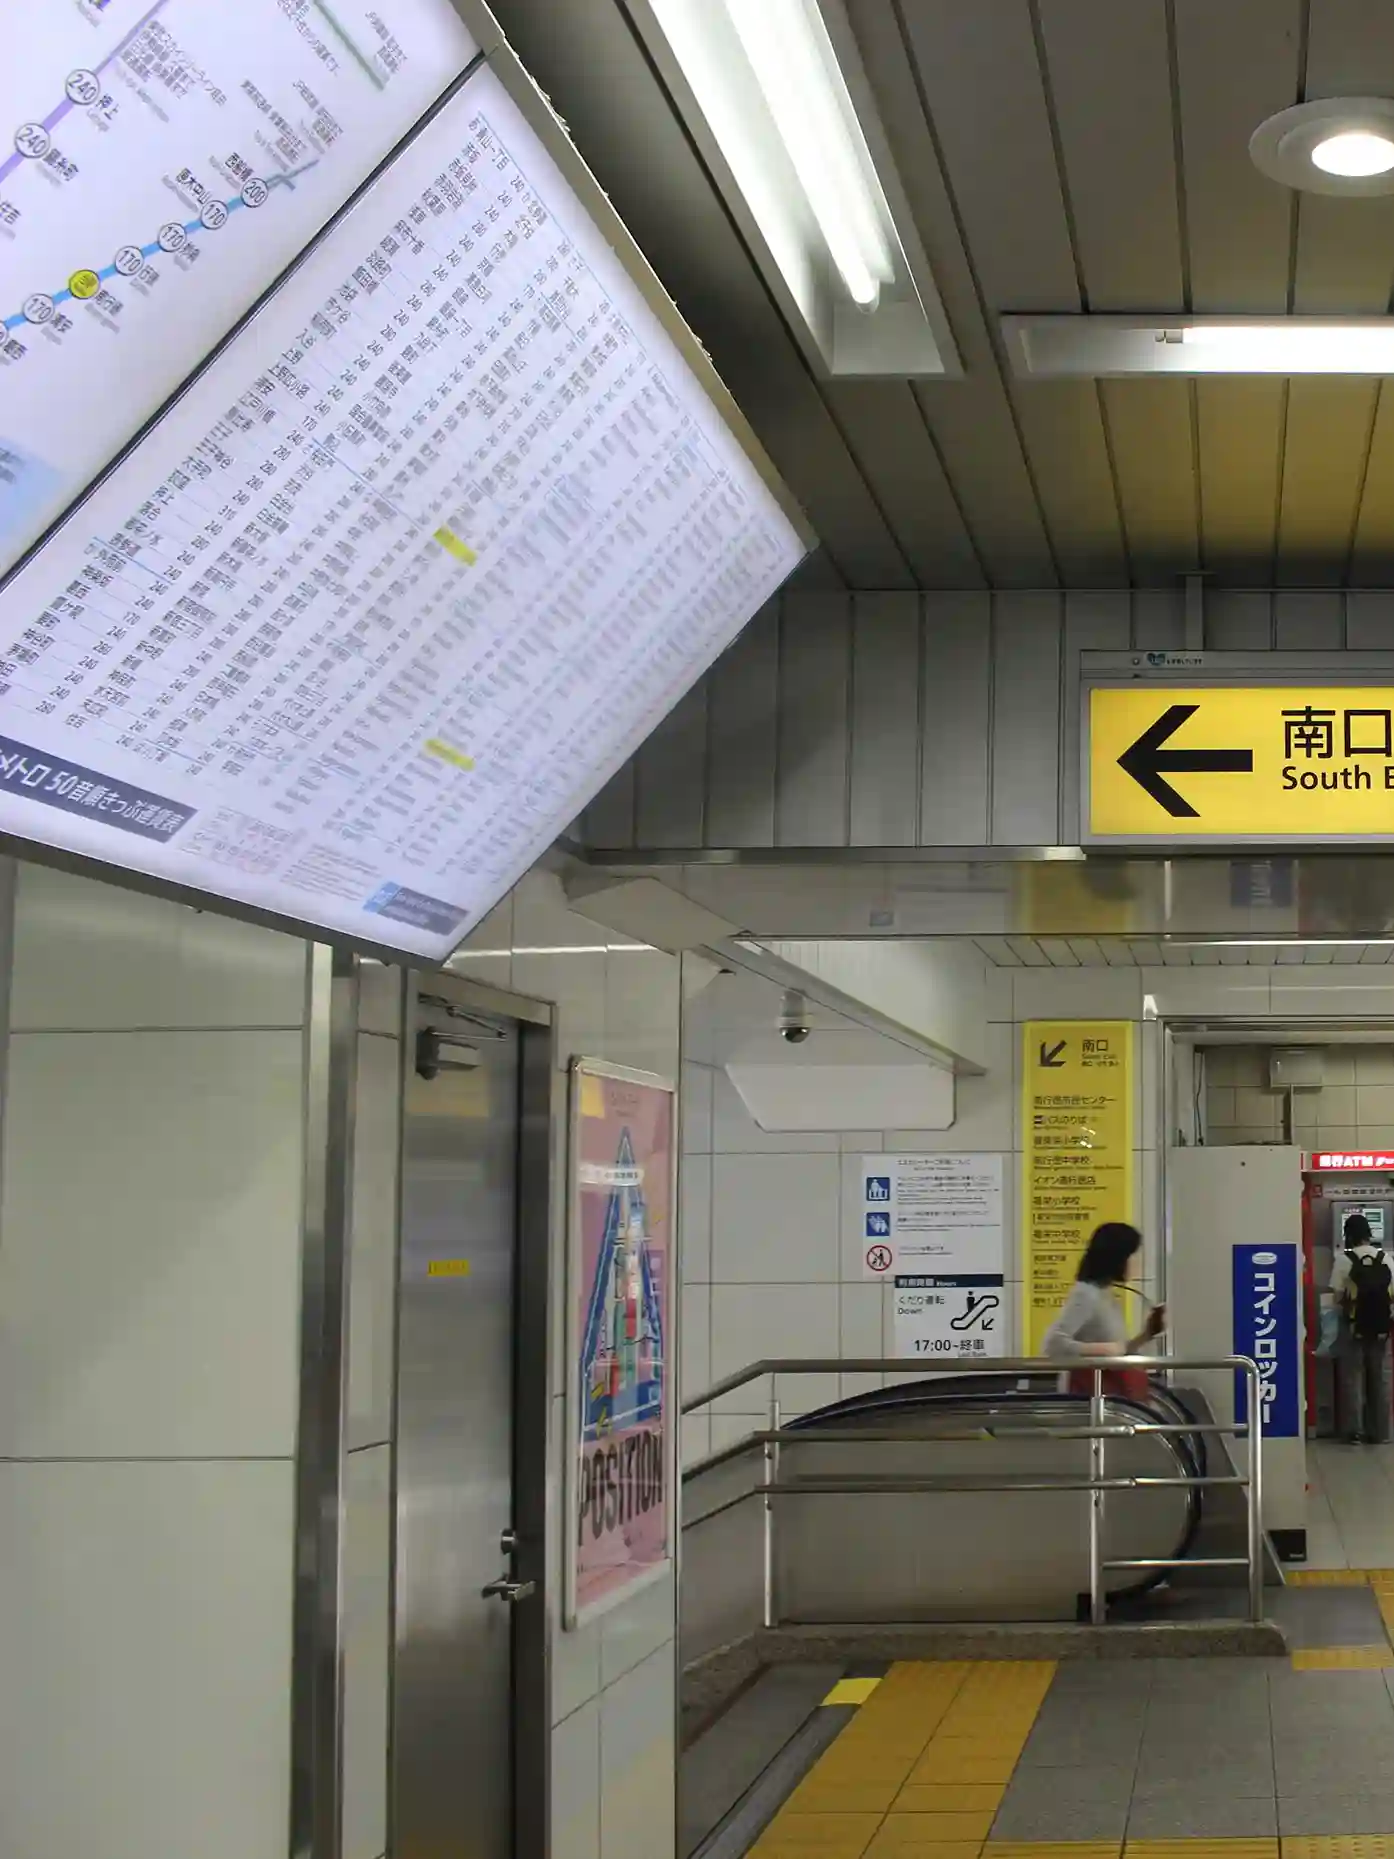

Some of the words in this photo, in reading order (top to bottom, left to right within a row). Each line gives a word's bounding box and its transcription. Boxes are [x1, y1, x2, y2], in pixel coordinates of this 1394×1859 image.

[65, 71, 99, 103] 240
[15, 124, 49, 156] 240
[242, 179, 267, 205] 200
[201, 202, 227, 228] 170
[159, 224, 184, 248] 170
[115, 248, 142, 272] 170
[23, 295, 54, 322] 170
[1281, 706, 1393, 759] 南口
[1281, 766, 1372, 791] South
[1082, 1038, 1108, 1053] 南口
[1254, 1271, 1279, 1424] コインロッカー
[577, 1431, 663, 1547] POSITION
